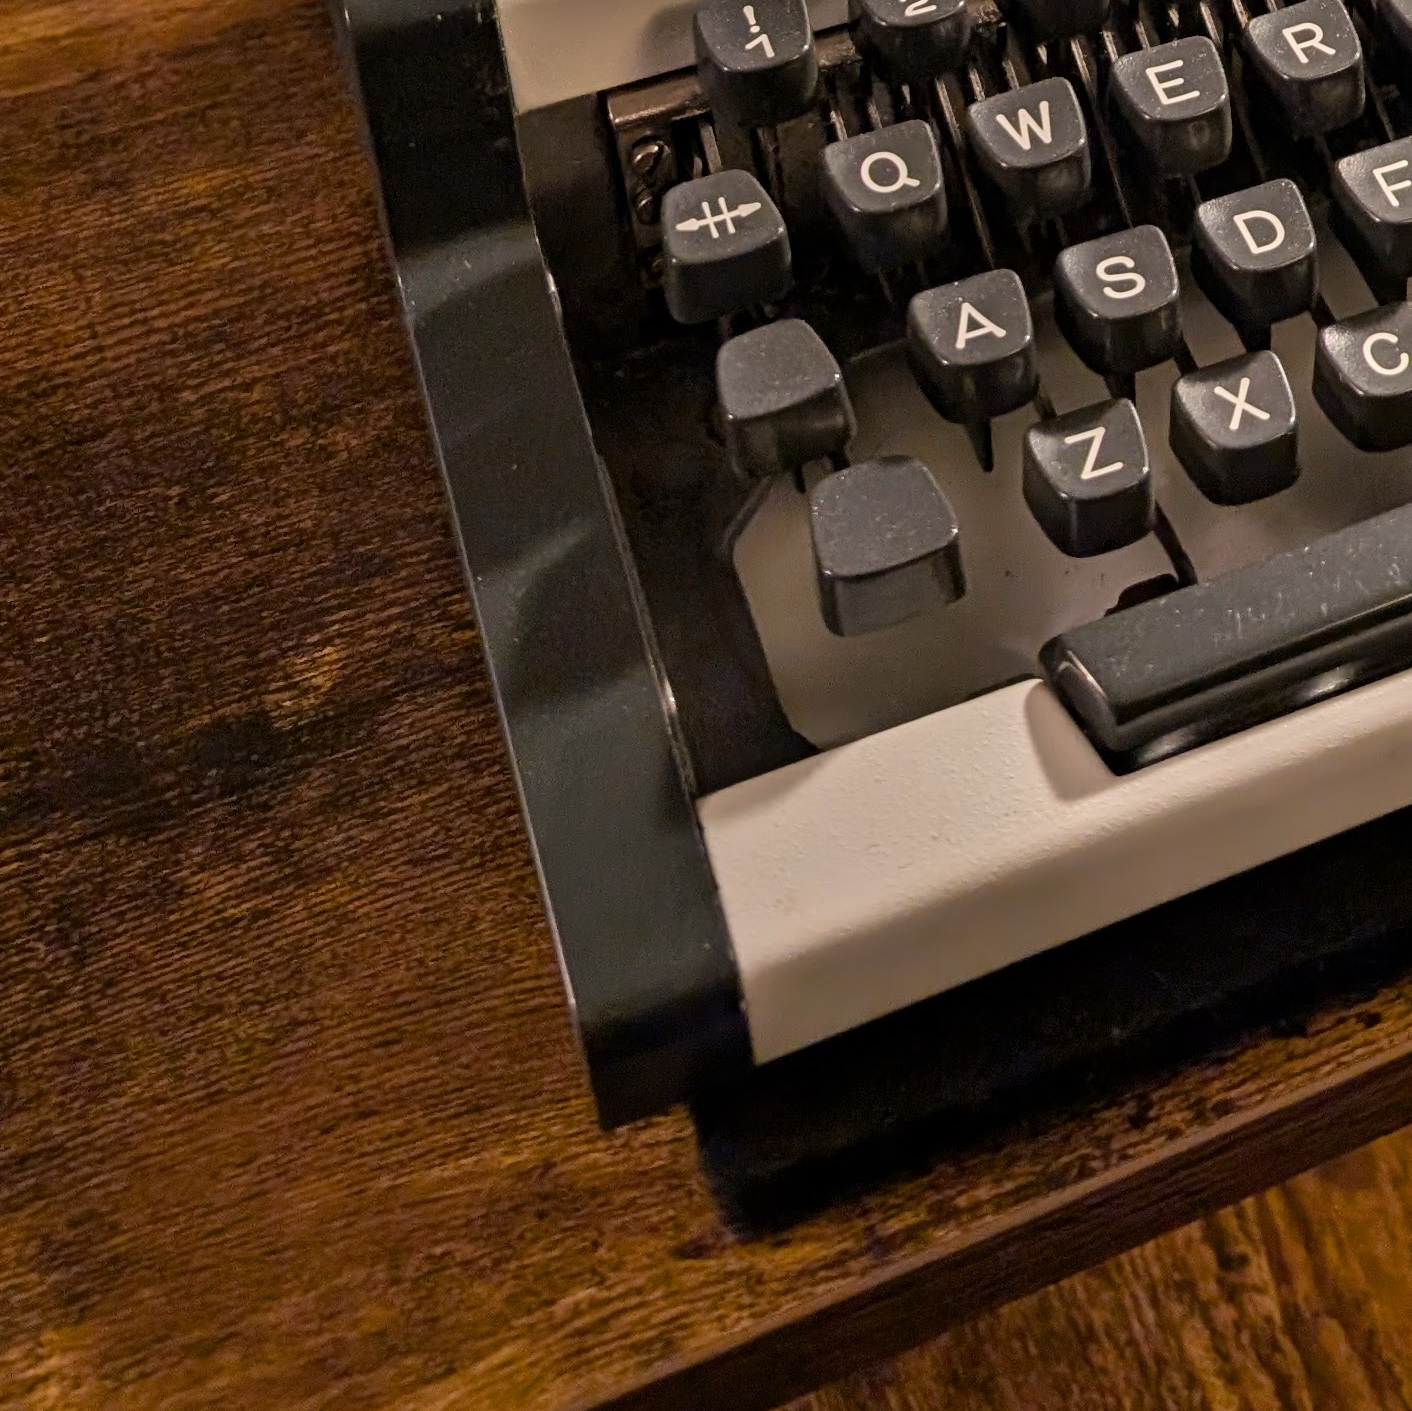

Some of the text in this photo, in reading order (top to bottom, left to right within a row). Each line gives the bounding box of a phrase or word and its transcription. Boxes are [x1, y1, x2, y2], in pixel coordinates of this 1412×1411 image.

[745, 34, 775, 57] 1
[1282, 21, 1336, 64] R
[1145, 59, 1201, 106] E
[996, 101, 1052, 150] W
[860, 151, 921, 193] Q
[1372, 159, 1412, 207] F
[1233, 210, 1286, 255] D
[1096, 255, 1146, 299] S
[954, 301, 1007, 350] A
[1362, 331, 1410, 377] C
[1213, 377, 1271, 431] X
[1064, 426, 1125, 480] Z
